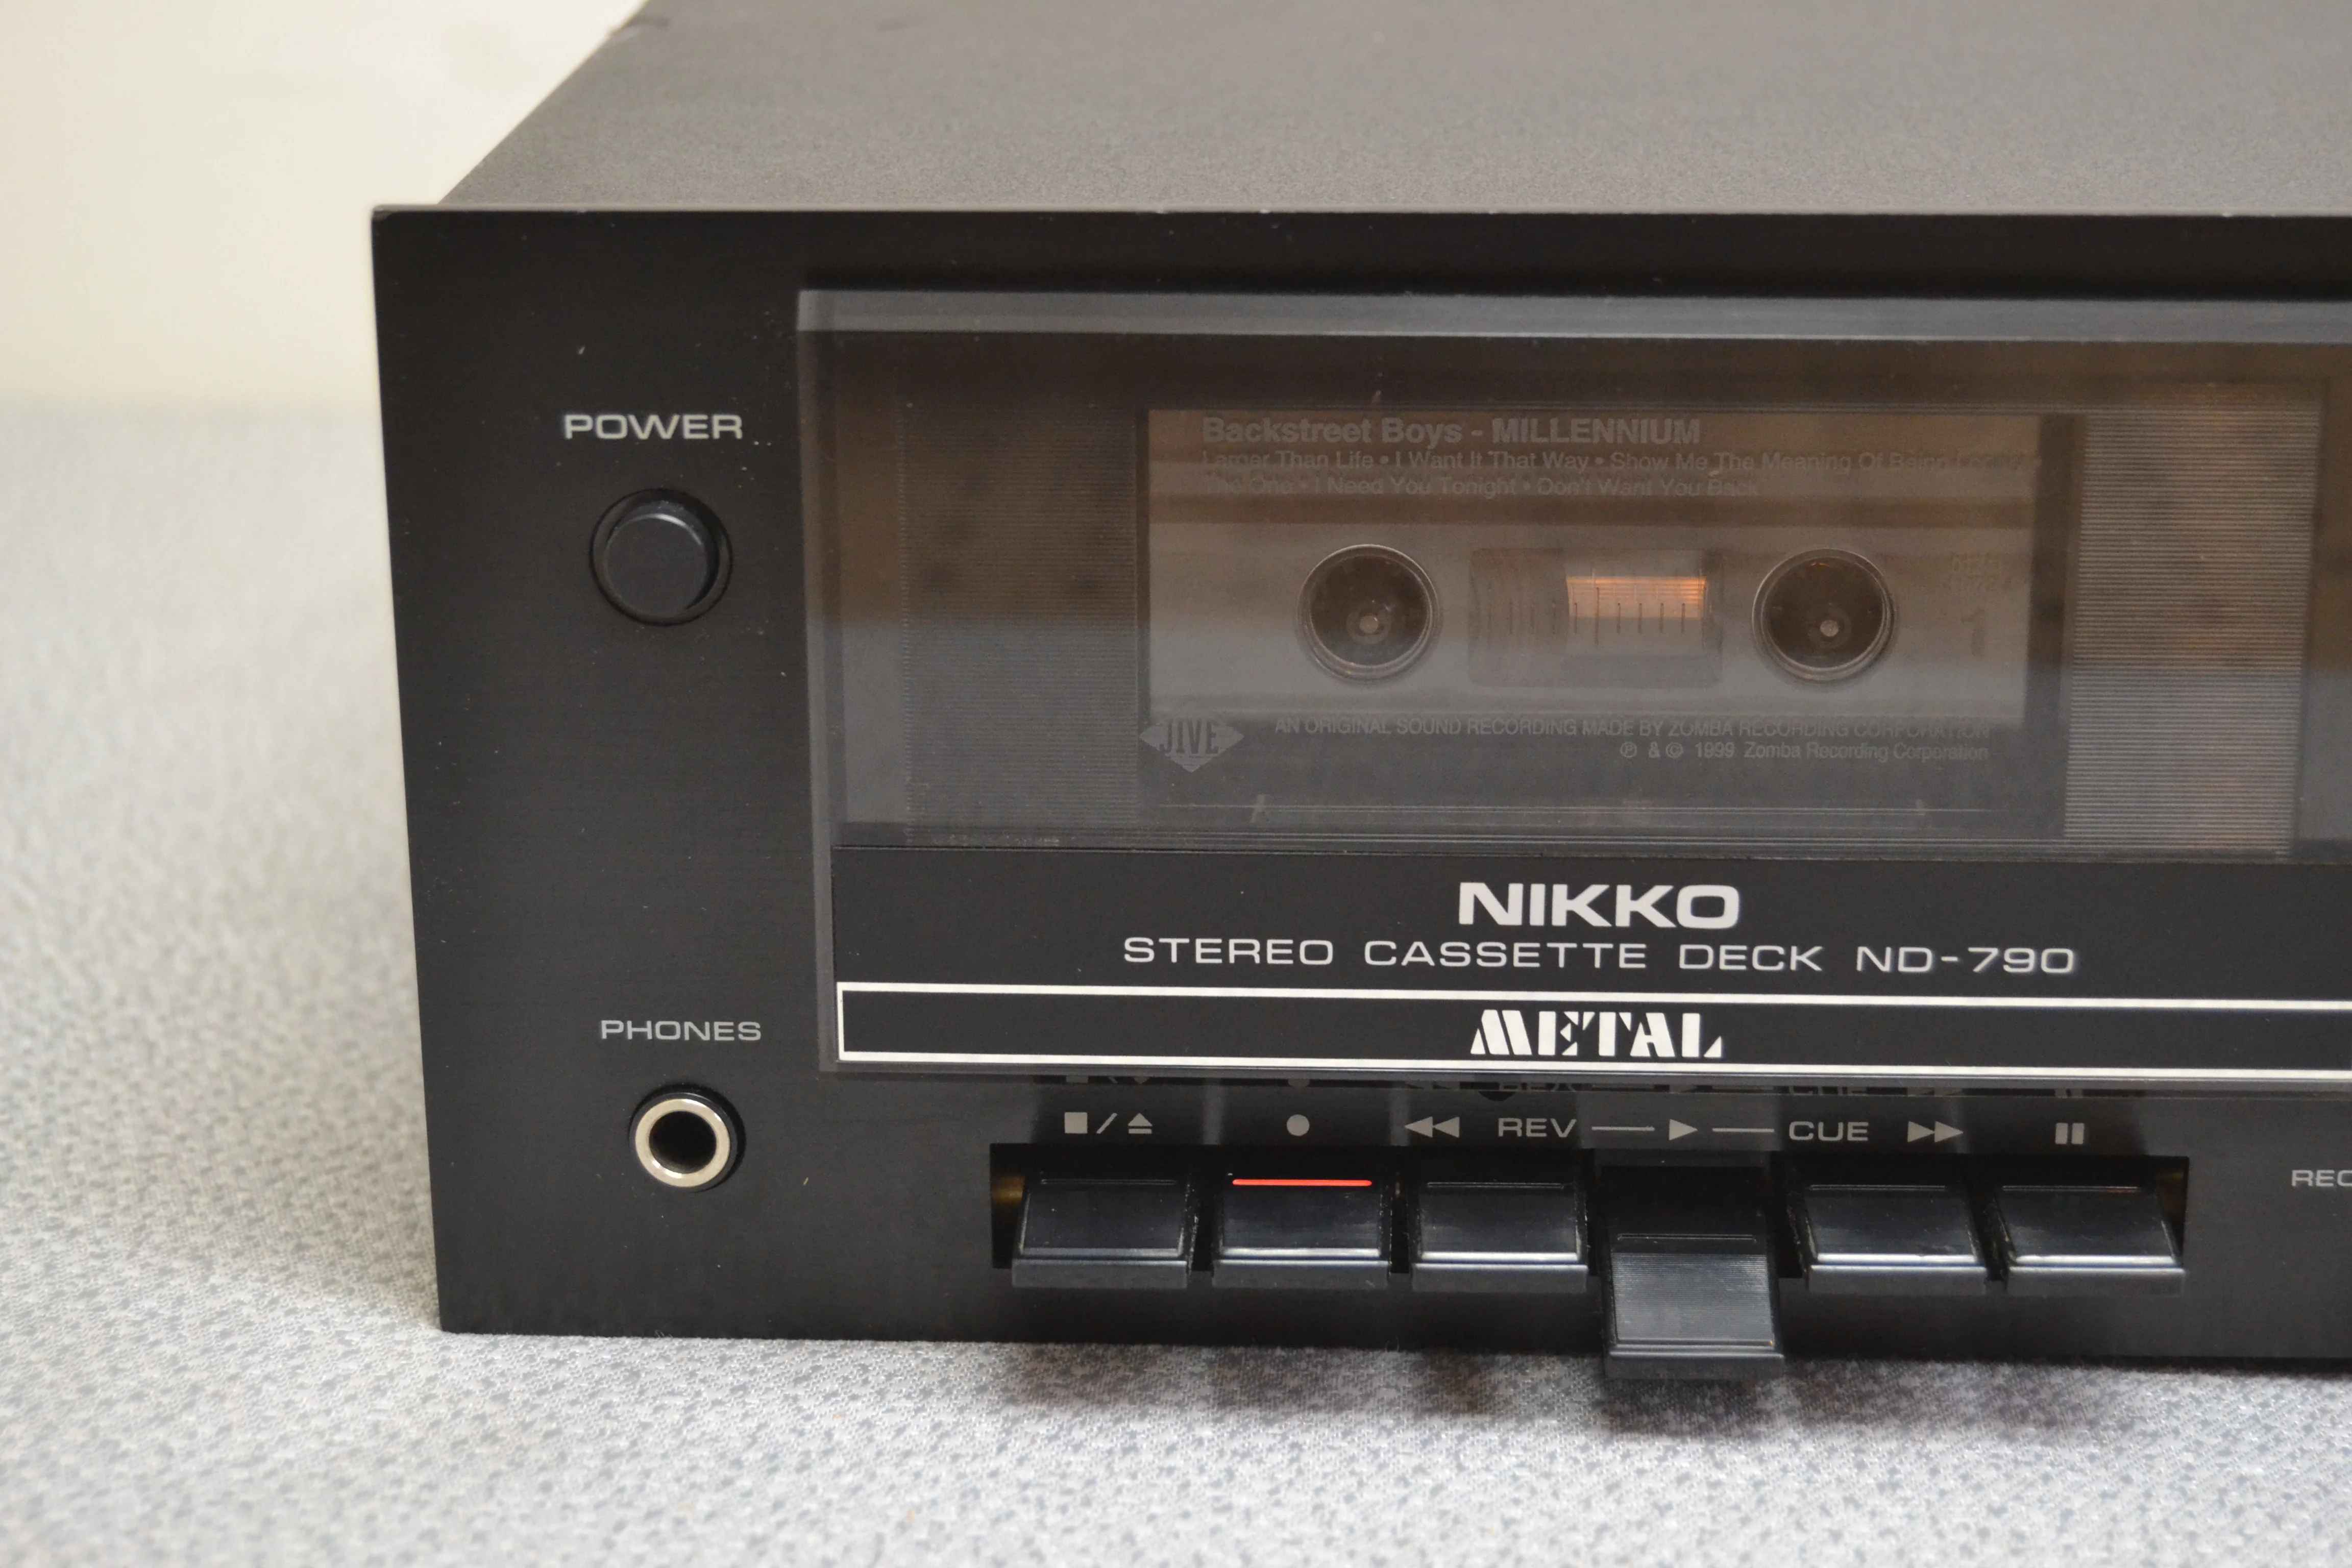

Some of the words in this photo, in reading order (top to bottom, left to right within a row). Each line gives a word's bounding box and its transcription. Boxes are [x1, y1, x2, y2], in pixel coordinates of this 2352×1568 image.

[565, 414, 742, 439] POWER
[1203, 416, 1371, 444] Backstreet
[1381, 416, 1463, 450] Boys
[1491, 416, 1700, 445] MILLENNIUM
[1275, 450, 1329, 469] Than
[1336, 450, 1374, 469] Life
[1407, 451, 1464, 469] Want
[1487, 451, 1535, 469] That
[1541, 451, 1589, 474] Way
[1610, 451, 1669, 470] Show
[1675, 452, 1708, 471] Me
[1713, 452, 1754, 471] The
[1761, 452, 1851, 476] Meaning
[1859, 451, 1884, 471] Of
[1327, 476, 1384, 494] Need
[1389, 476, 1431, 495] You
[1438, 476, 1516, 499] Tonight
[1537, 477, 1591, 495] Don't
[1597, 478, 1653, 496] Want
[1659, 478, 1701, 496] You
[1707, 478, 1758, 496] Back
[1159, 718, 1219, 754] JIVE
[1275, 718, 1300, 734] AN
[1305, 718, 1392, 735] ORIGINAL
[1395, 718, 1461, 736] SOUND
[1466, 718, 1577, 736] RECORDING
[1582, 719, 1634, 737] MADE
[1639, 719, 1662, 737] BY
[1695, 742, 1735, 758] 1999
[1744, 742, 1801, 758] Zomba
[1806, 742, 1889, 763] Recording
[1893, 743, 1990, 763] Corporation
[1459, 883, 1739, 929] NIKKO
[1124, 937, 1333, 965] STEREO
[1365, 941, 1646, 968] CASSETTE
[1679, 945, 1822, 971] DECK
[1857, 947, 2074, 973] ND-790
[601, 1020, 761, 1041] PHONES
[1471, 1010, 1722, 1058] METAL
[1499, 1118, 1577, 1137] REV
[1790, 1121, 1868, 1141] CUE
